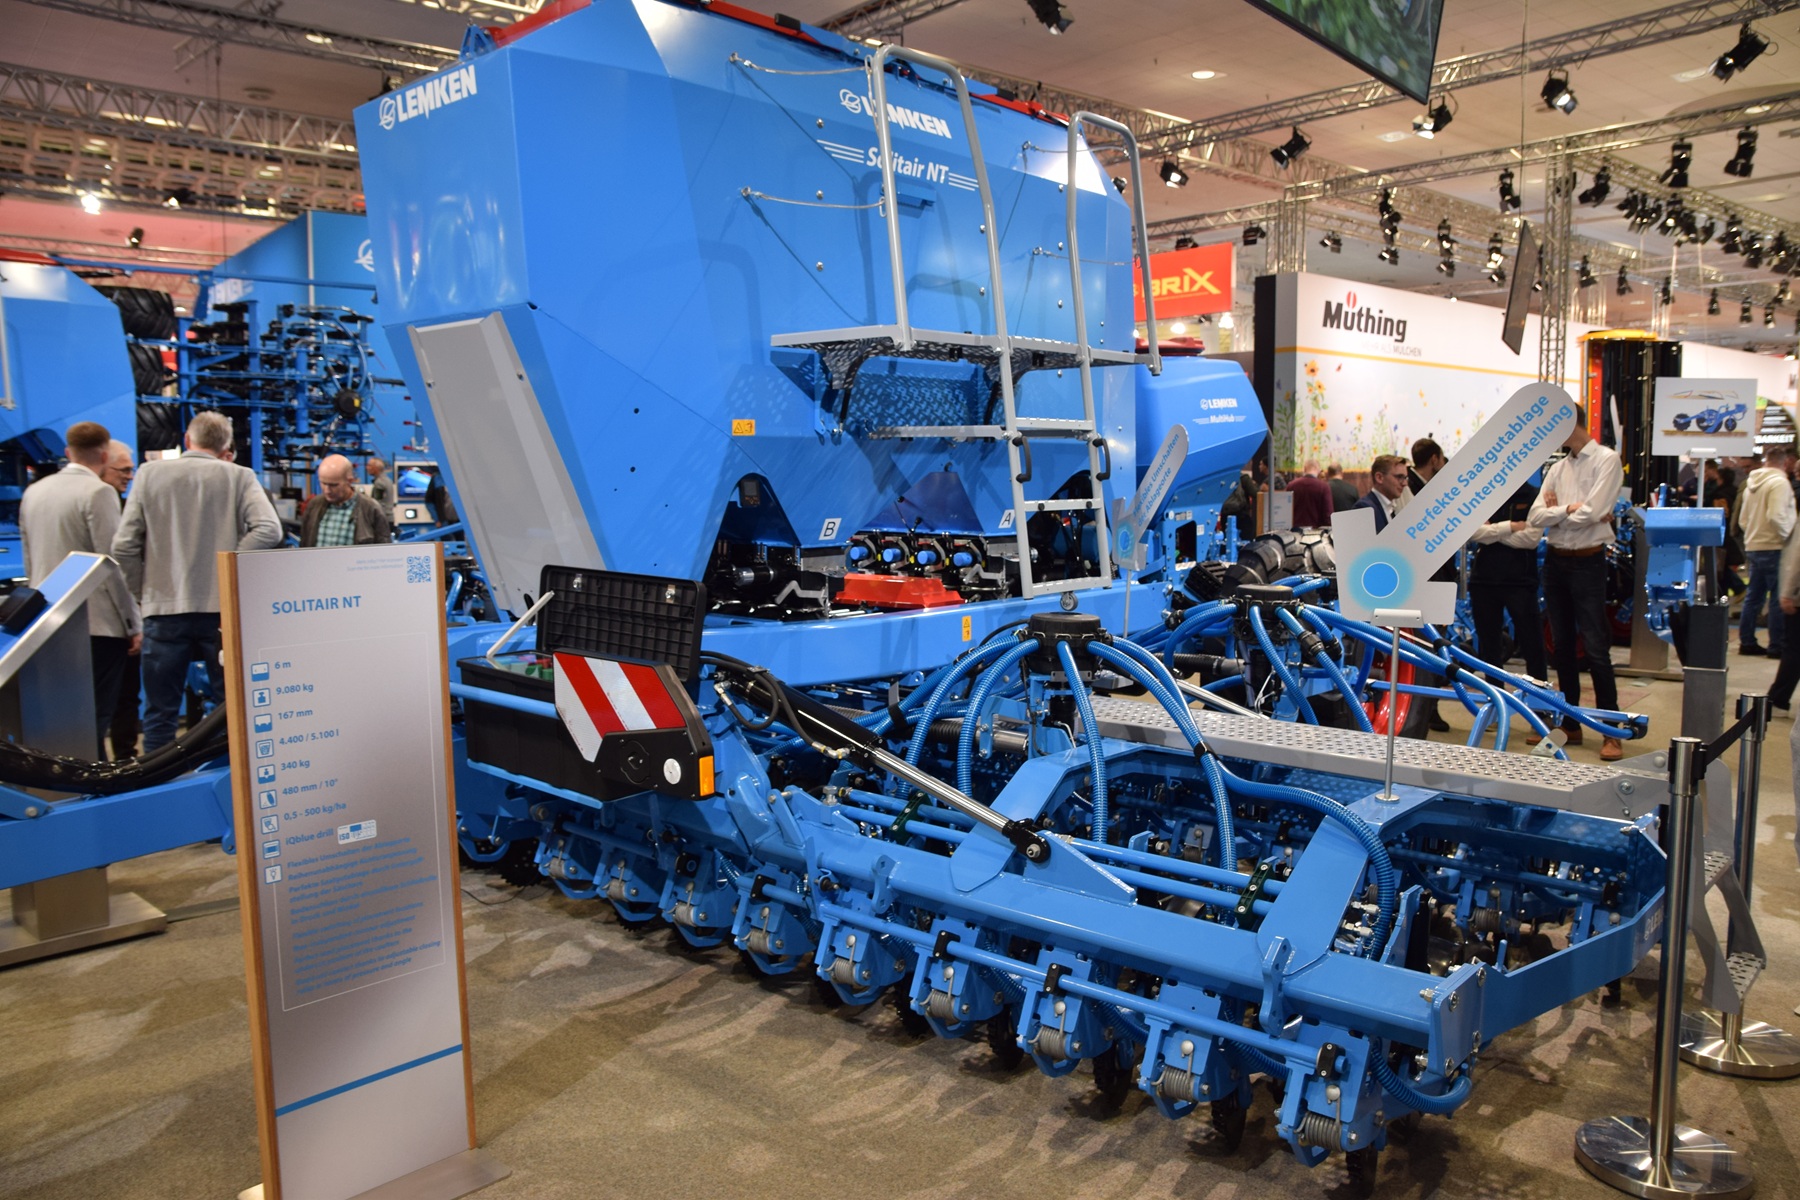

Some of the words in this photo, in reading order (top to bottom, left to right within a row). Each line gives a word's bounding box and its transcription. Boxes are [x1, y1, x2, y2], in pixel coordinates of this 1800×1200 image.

[395, 64, 478, 123] LEMKEN
[926, 162, 950, 184] NT
[1208, 398, 1238, 409] LEMKEN
[1151, 433, 1180, 483] Umschalten
[1405, 484, 1462, 540] Perfekte
[1457, 394, 1550, 488] Saatgutablage
[1423, 515, 1463, 554] durch
[1456, 403, 1574, 517] Untergriffstellung
[1145, 466, 1173, 513] Ablageorte
[1002, 512, 1012, 526] A
[823, 521, 836, 537] B
[272, 597, 340, 615] SOLITAIR
[343, 595, 362, 609] NT
[274, 661, 281, 670] 6
[282, 661, 292, 670] m
[275, 684, 301, 695] 9.080
[302, 683, 314, 693] kg
[278, 711, 294, 720] 167
[296, 709, 313, 718] mm
[279, 734, 304, 746] 4.400
[311, 730, 335, 741] 5.100
[281, 761, 298, 771] 340
[299, 759, 310, 770] kg
[282, 785, 299, 796] 480
[300, 783, 318, 793] mm
[304, 806, 321, 817] 500
[322, 802, 347, 814] kg/ha
[285, 833, 315, 846] iQblue
[316, 828, 334, 840] drill
